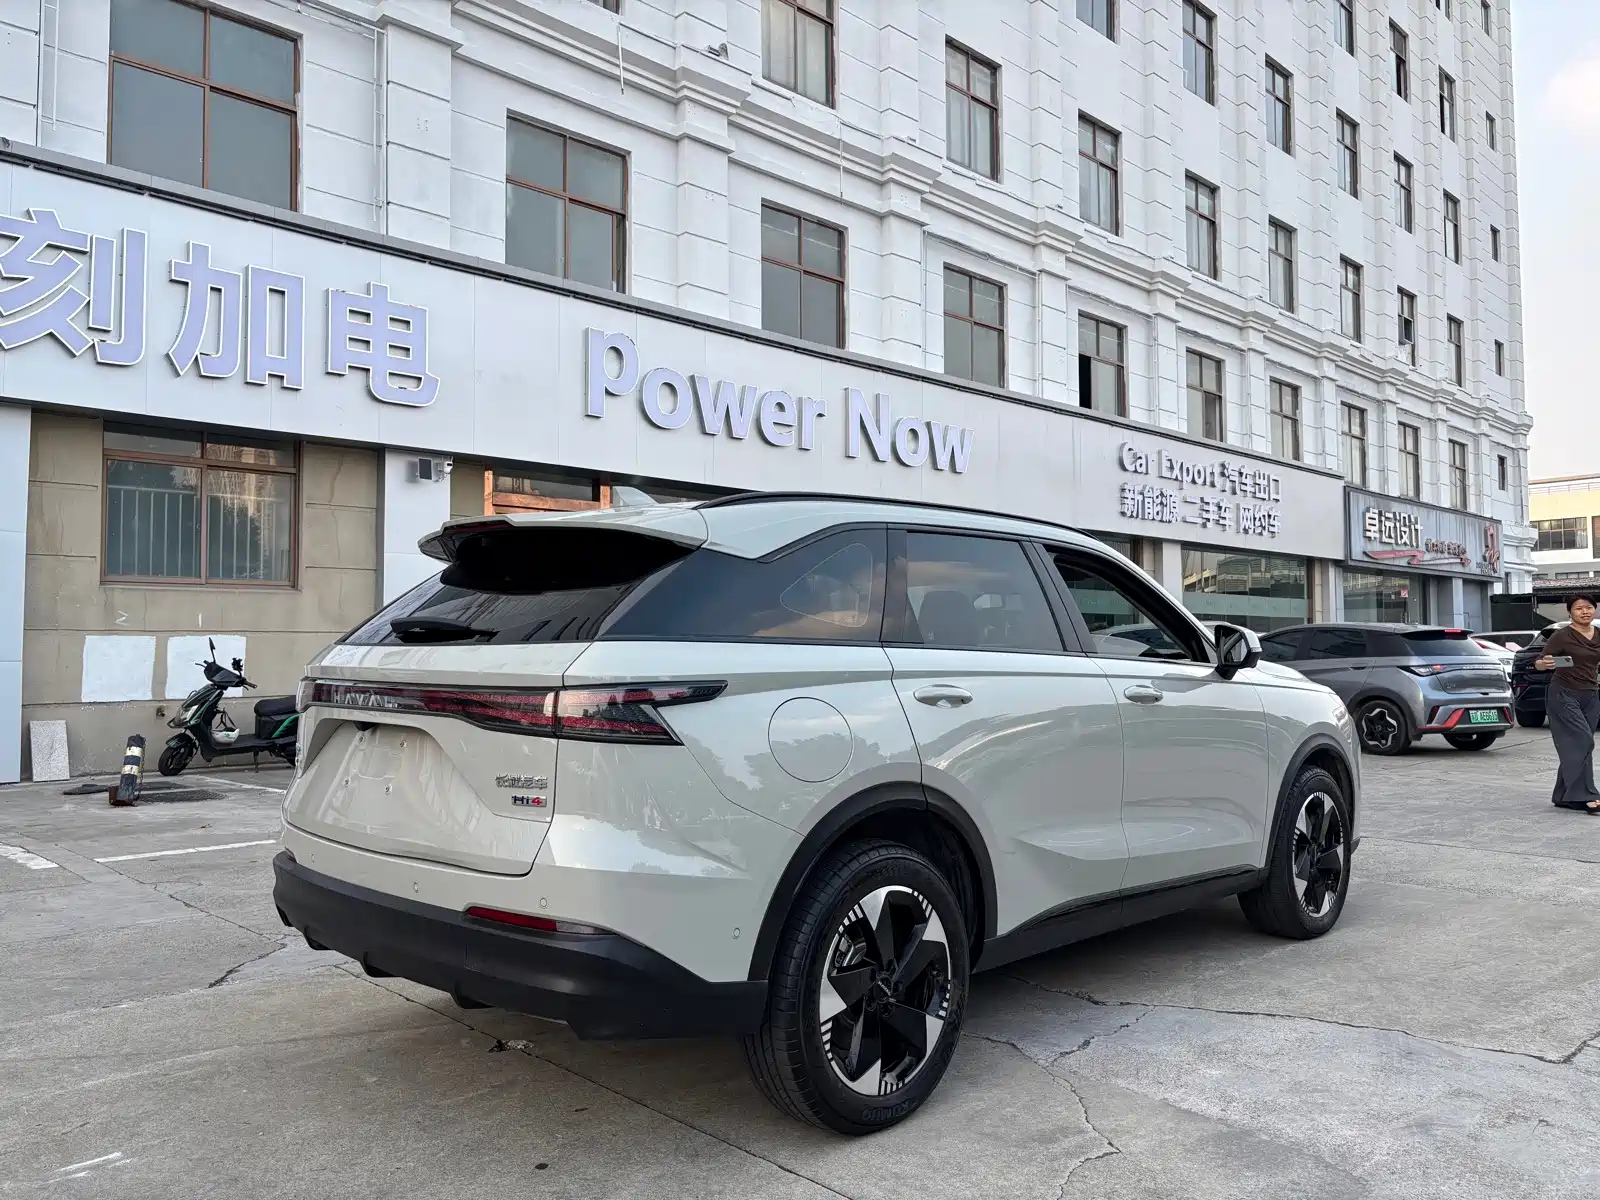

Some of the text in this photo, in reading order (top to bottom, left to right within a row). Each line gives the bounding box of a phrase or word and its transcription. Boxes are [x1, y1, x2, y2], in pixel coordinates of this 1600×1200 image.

[0, 207, 441, 407] 刻加电
[842, 386, 975, 474] Now
[1157, 448, 1220, 490] Export
[1220, 459, 1282, 503] 汽车出口
[1120, 481, 1282, 538] 新能源 二手车 网约车
[1363, 506, 1424, 549] 卓远设计
[333, 691, 394, 708] HAVAL
[512, 795, 545, 806] Hi4
